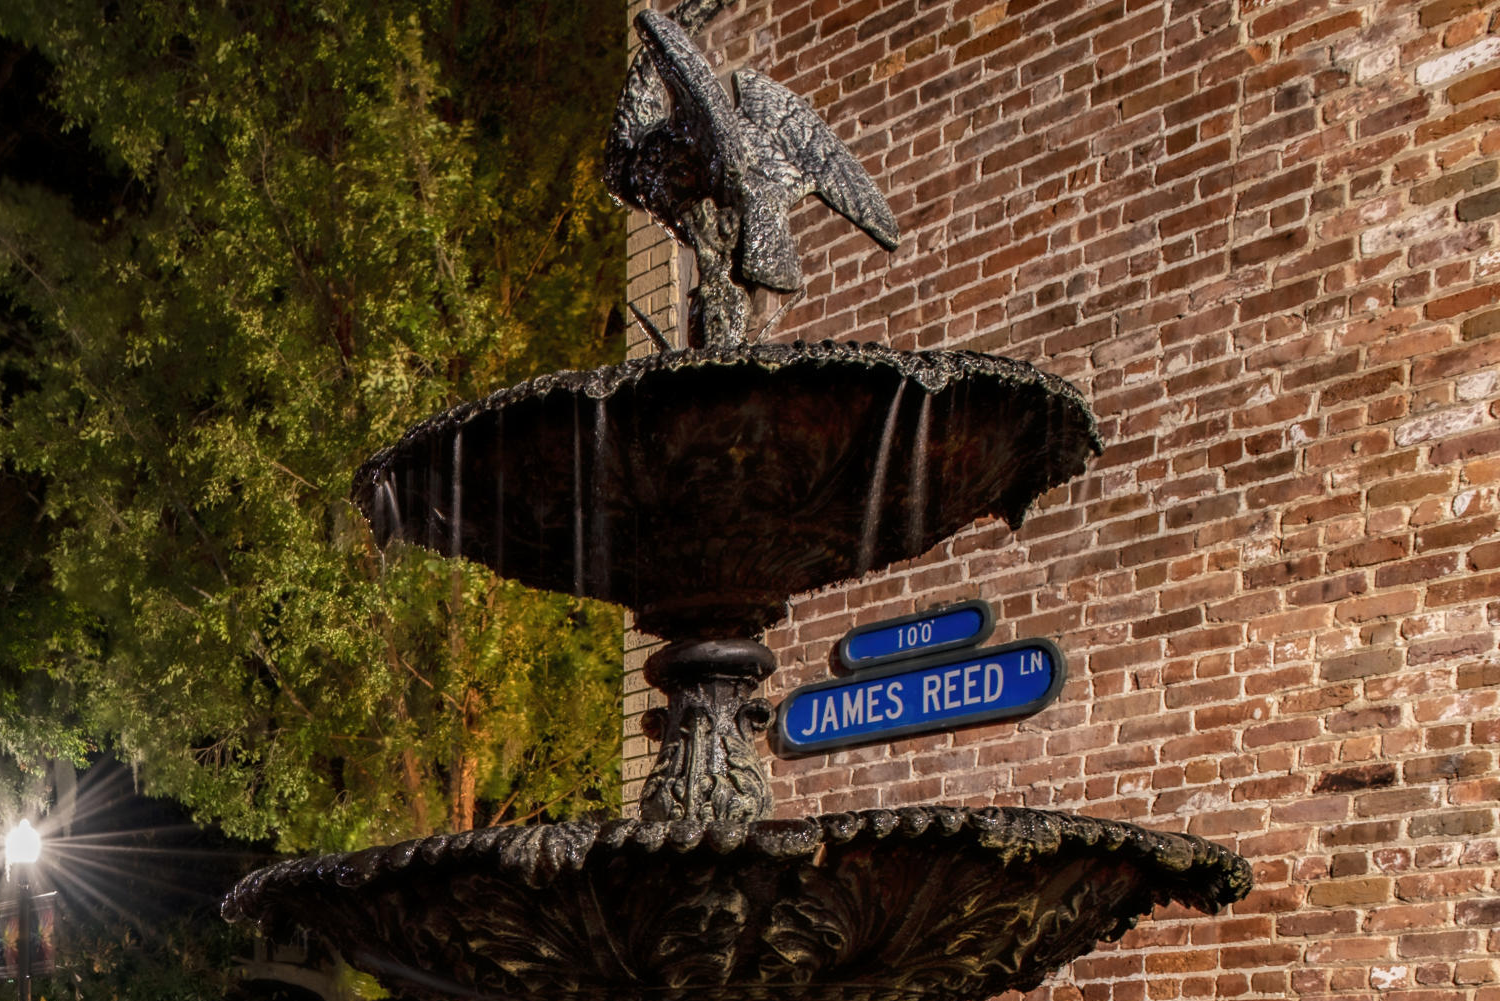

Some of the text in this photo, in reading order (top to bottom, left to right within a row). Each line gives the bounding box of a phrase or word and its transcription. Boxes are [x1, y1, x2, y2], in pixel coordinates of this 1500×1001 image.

[897, 622, 932, 649] 100
[801, 651, 1043, 736] JAMES REED LN
